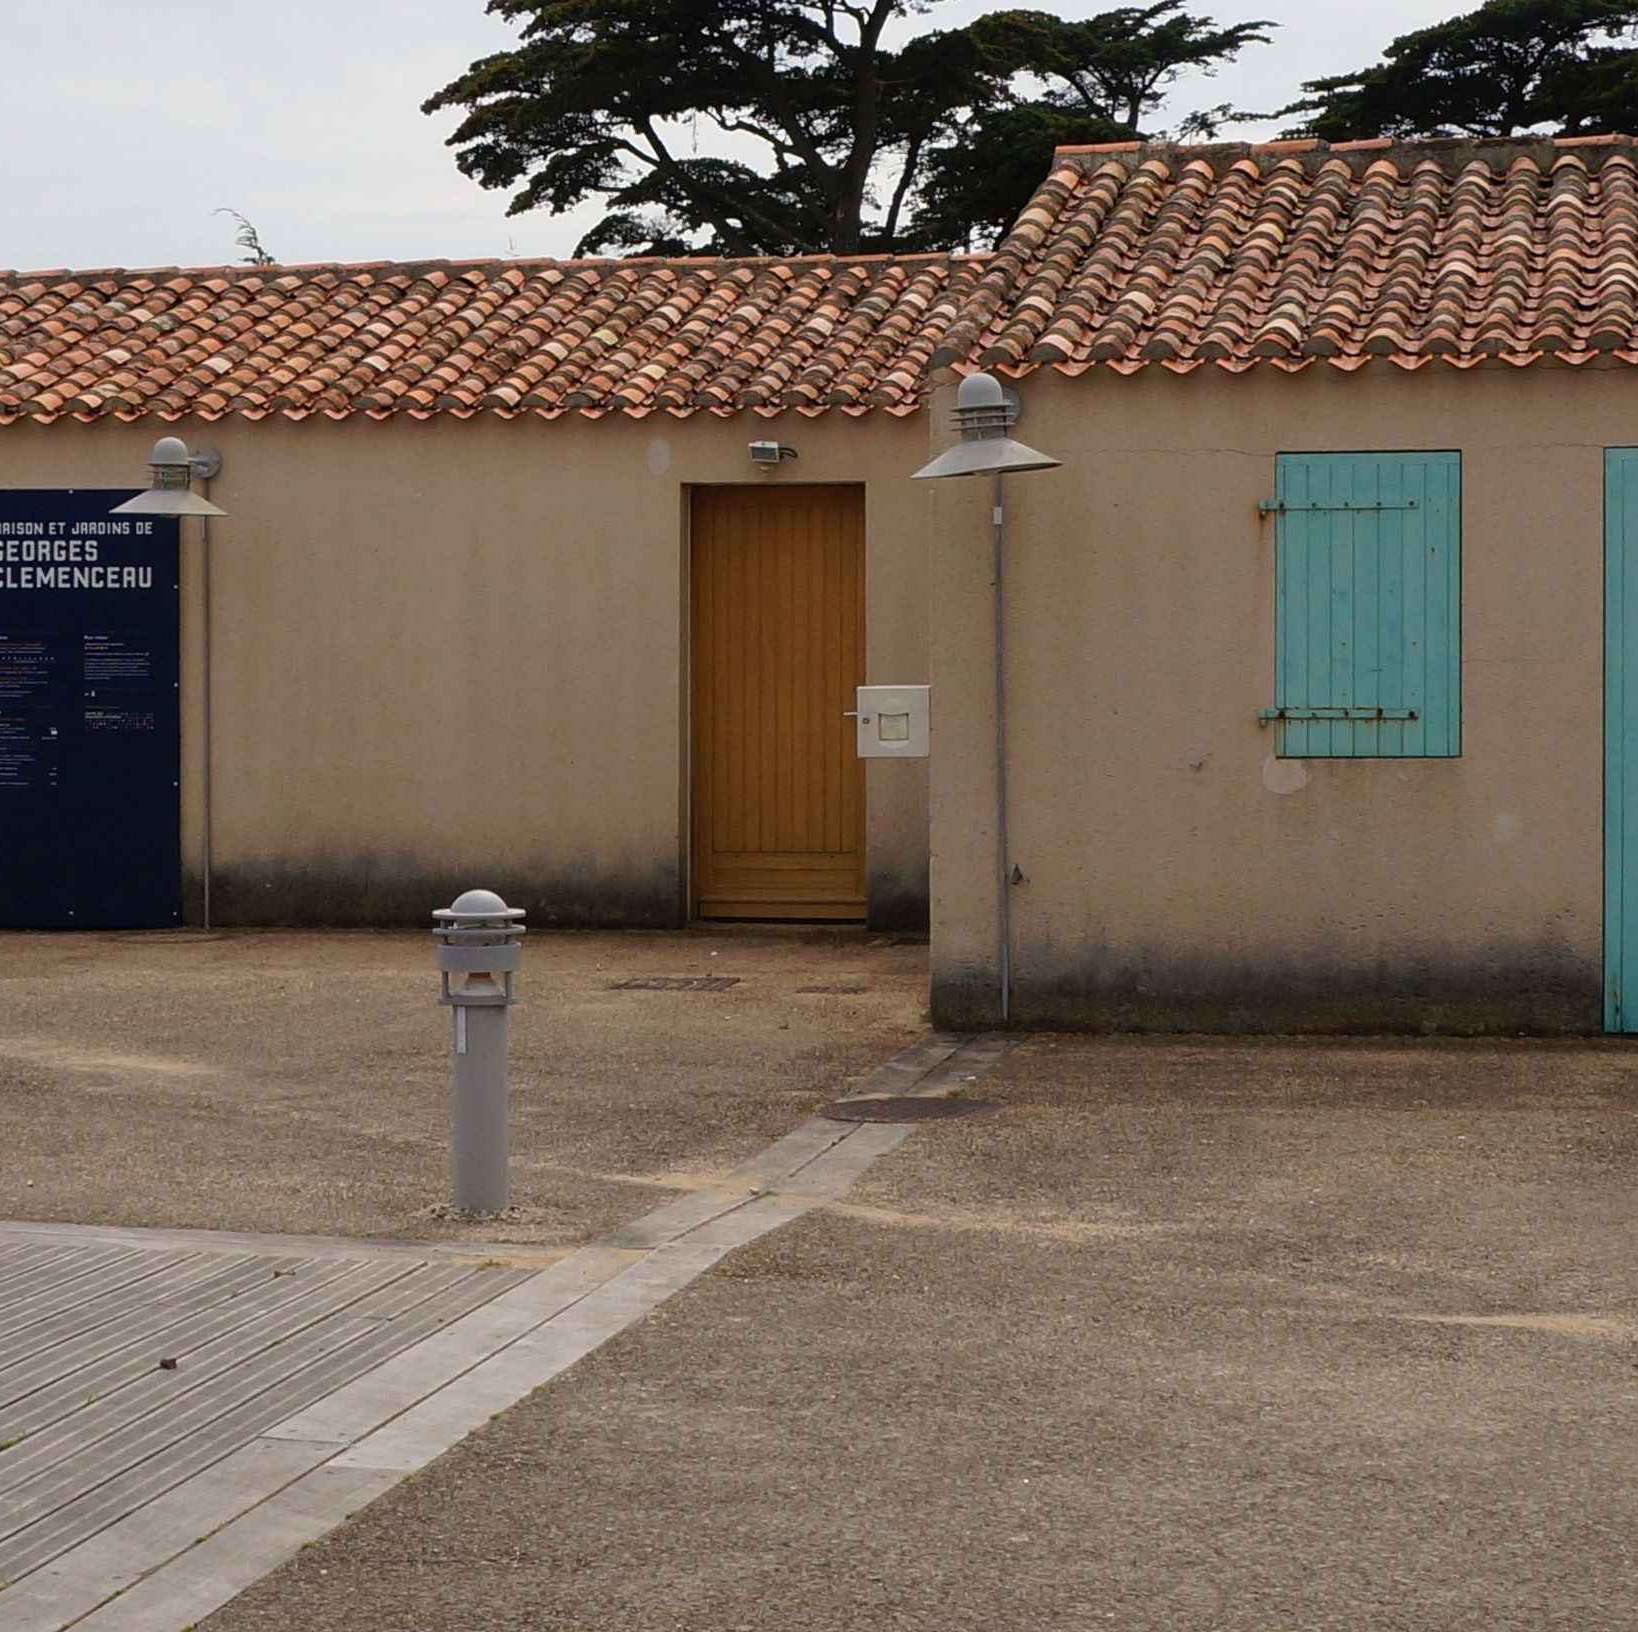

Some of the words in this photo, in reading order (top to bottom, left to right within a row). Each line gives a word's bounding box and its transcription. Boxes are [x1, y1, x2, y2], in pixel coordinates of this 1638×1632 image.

[49, 522, 66, 535] ET
[71, 522, 130, 534] JARDINS
[136, 522, 153, 534] DE
